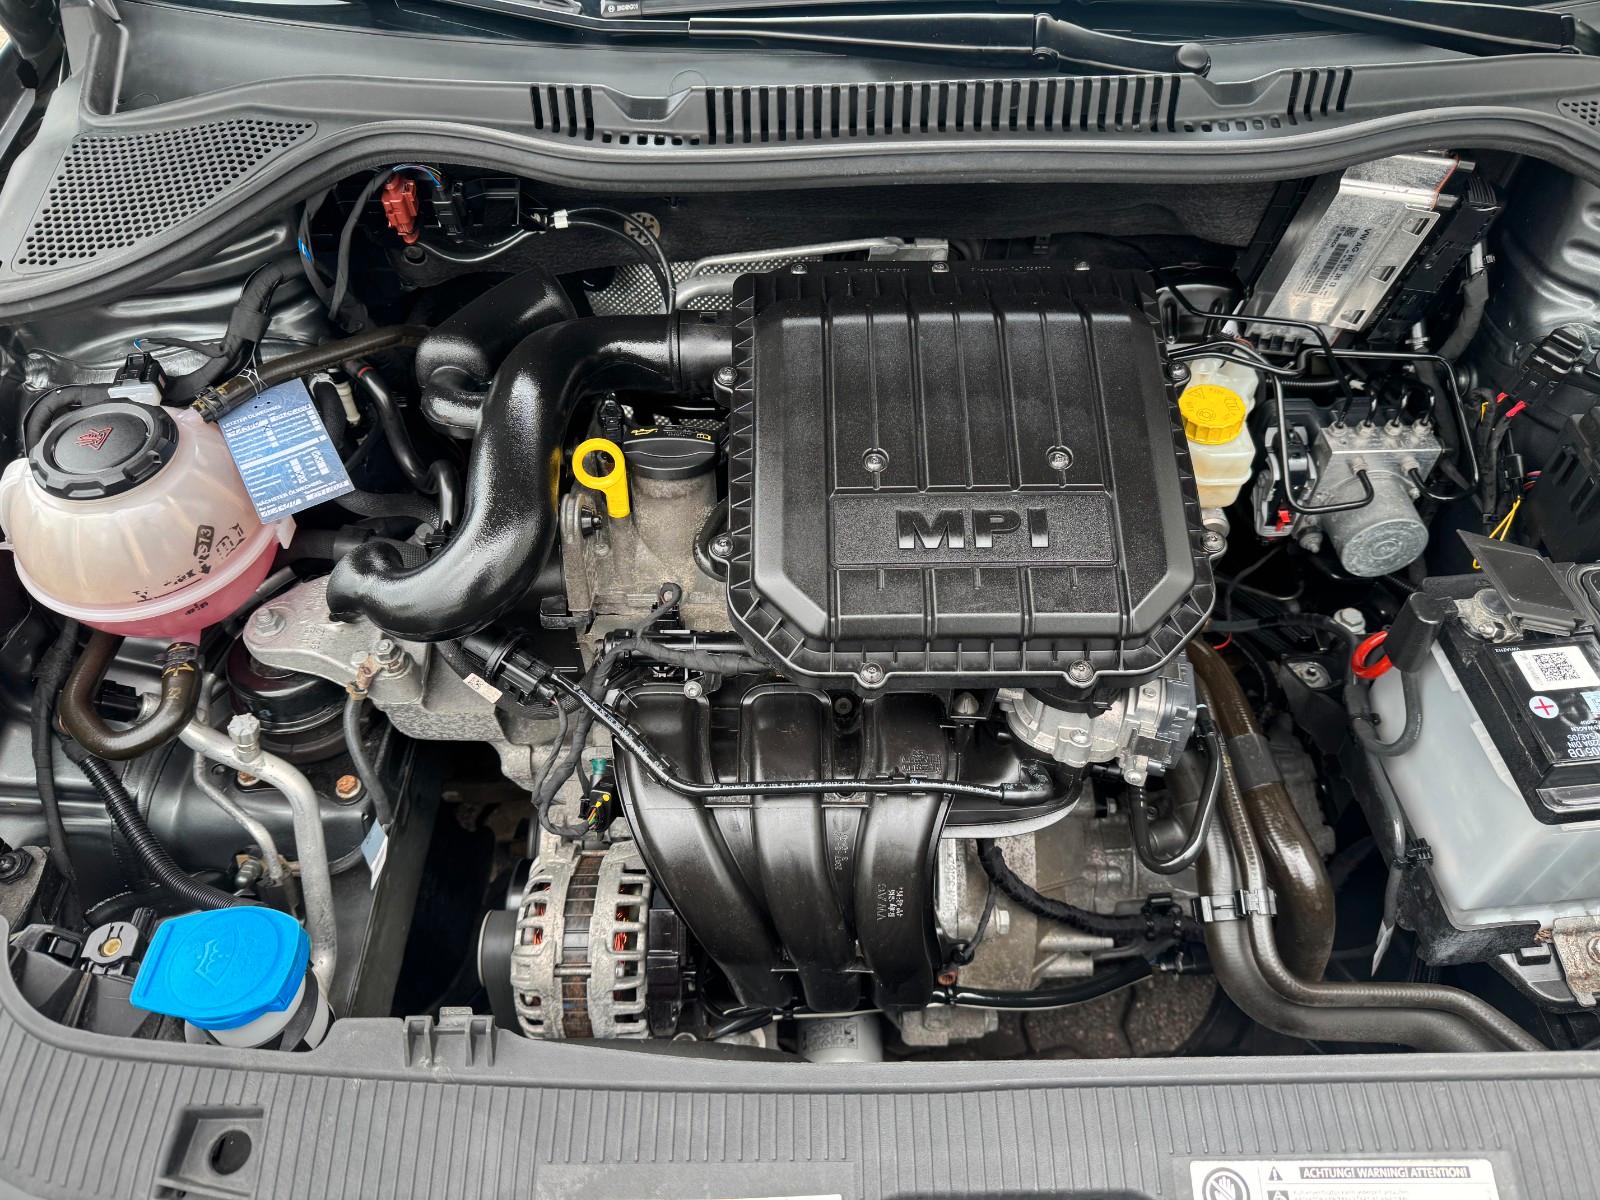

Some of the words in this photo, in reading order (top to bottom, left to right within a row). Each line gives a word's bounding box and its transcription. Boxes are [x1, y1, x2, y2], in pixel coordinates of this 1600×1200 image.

[1360, 228, 1372, 241] VW
[1350, 241, 1363, 253] AG
[896, 507, 1050, 550] MPI
[1303, 1167, 1355, 1178] ACHTUNG!
[1356, 1167, 1408, 1178] WARNING!
[1410, 1167, 1468, 1178] ATTENTION!
